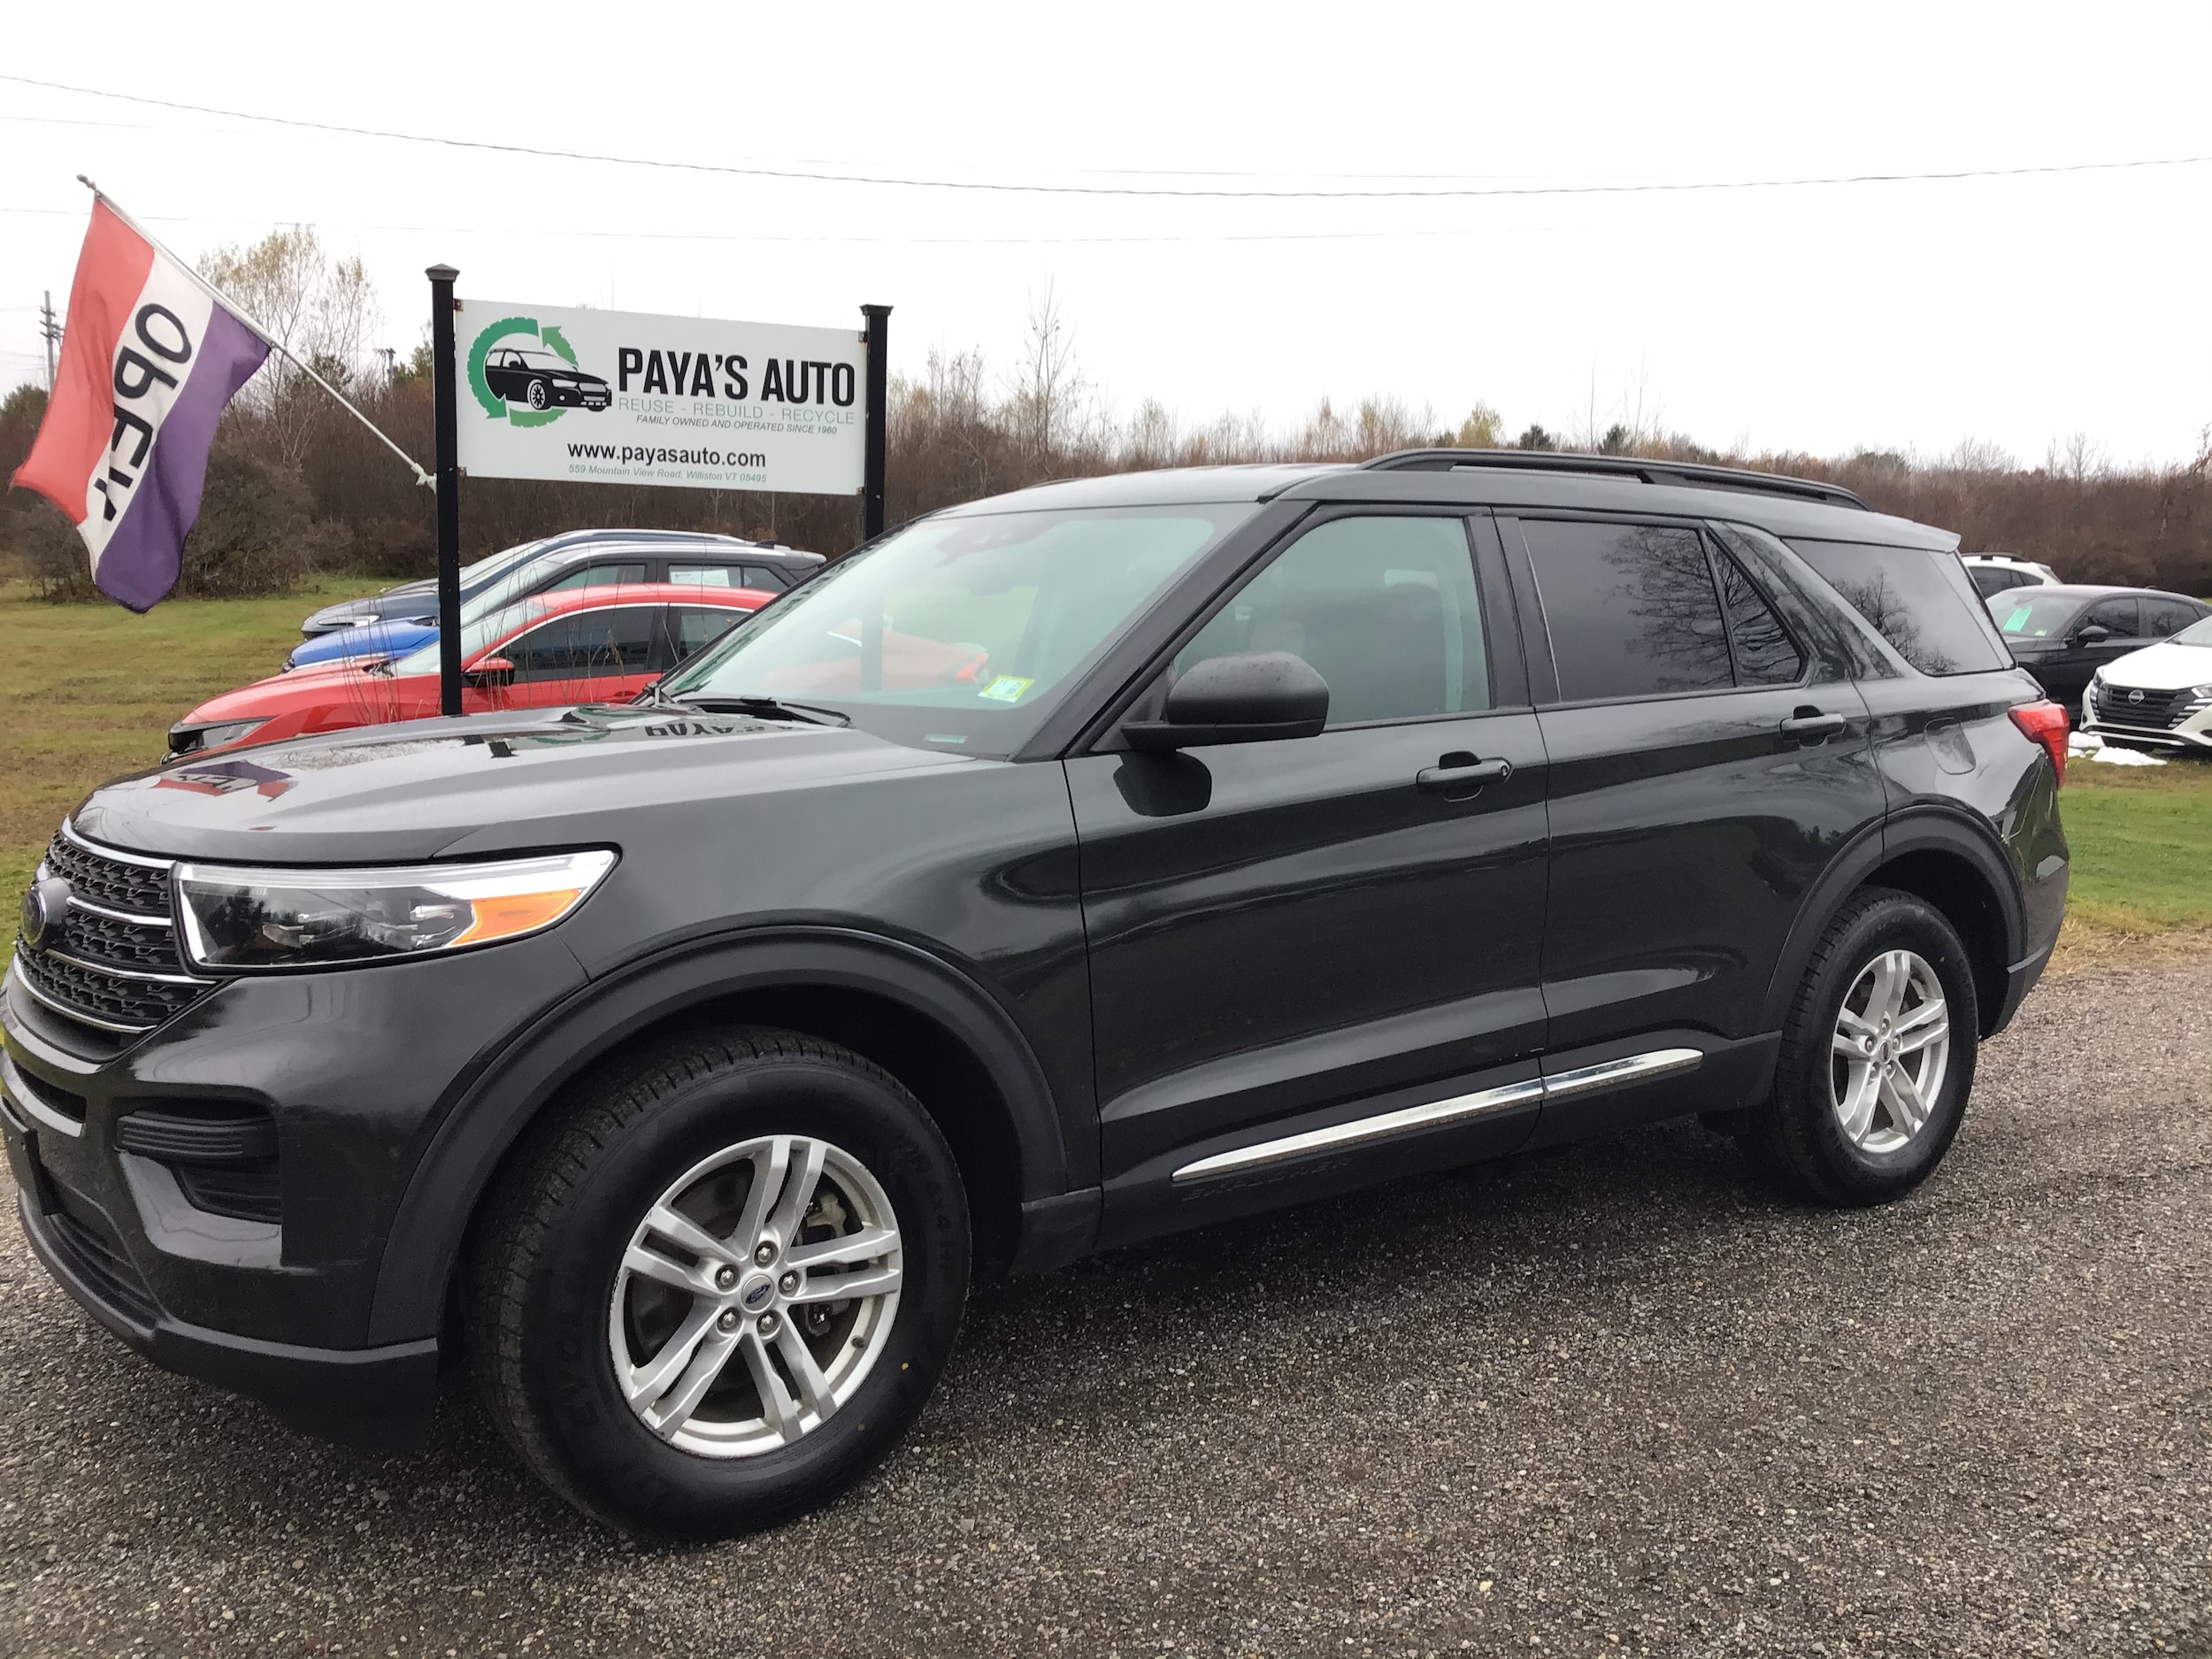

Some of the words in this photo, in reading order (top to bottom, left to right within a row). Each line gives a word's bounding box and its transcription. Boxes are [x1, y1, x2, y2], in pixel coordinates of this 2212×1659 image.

[618, 347, 749, 400] PAYA'S
[761, 358, 855, 407] AUTO
[618, 397, 674, 414] REUSE
[694, 403, 764, 419] REBUILD
[782, 408, 855, 425] RECYCLE
[636, 415, 670, 425] FAMILY
[672, 417, 710, 427] OWNED
[710, 419, 731, 429] AND
[733, 420, 784, 432] OPERATED
[786, 423, 814, 434] SINCE
[818, 426, 838, 435] 1960
[567, 442, 766, 467] www.payasauto.com
[568, 464, 586, 473] 559
[588, 465, 630, 476] Mountain
[634, 467, 655, 477] View
[657, 469, 683, 480] Road,
[686, 470, 723, 480] Williston
[726, 472, 738, 481] VT
[740, 473, 767, 483] 05495
